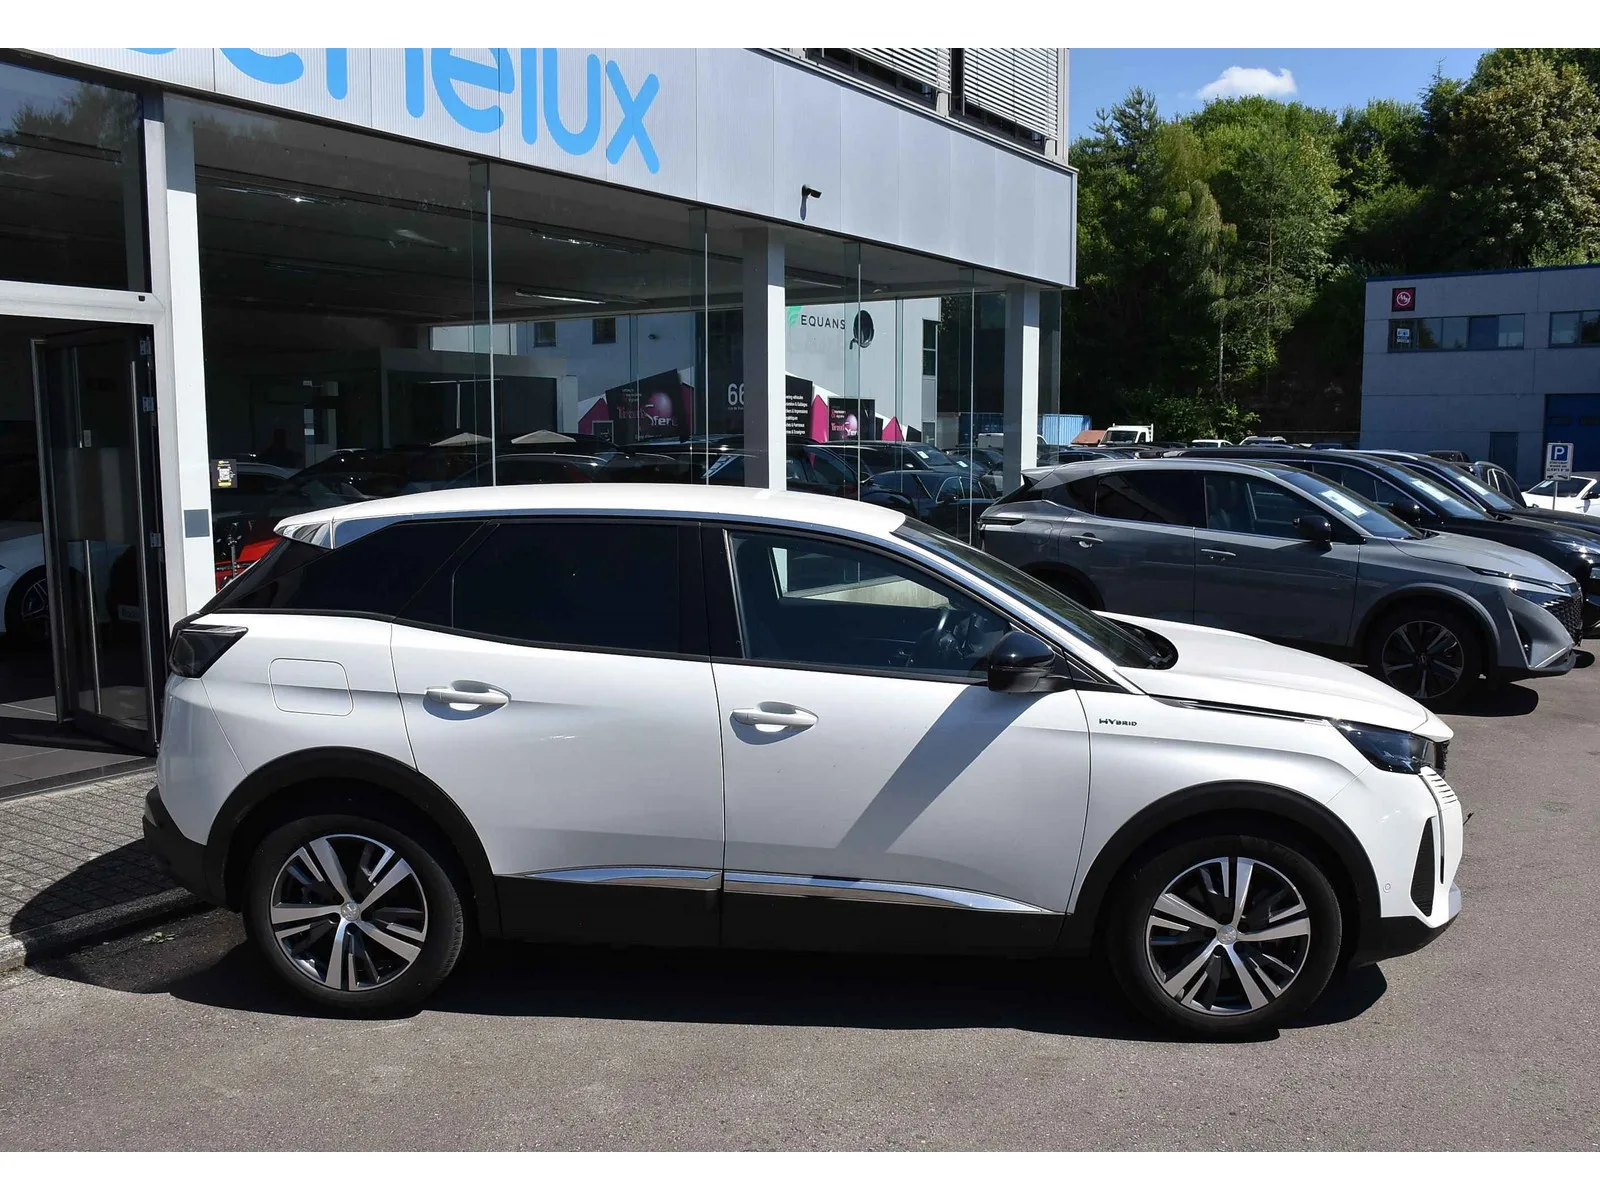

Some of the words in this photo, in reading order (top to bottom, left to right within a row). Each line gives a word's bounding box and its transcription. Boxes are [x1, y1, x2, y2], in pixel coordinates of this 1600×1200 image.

[127, 48, 660, 174] elux
[800, 314, 846, 330] EQUANS
[1554, 446, 1565, 460] P
[1098, 718, 1138, 727] HYBRID
